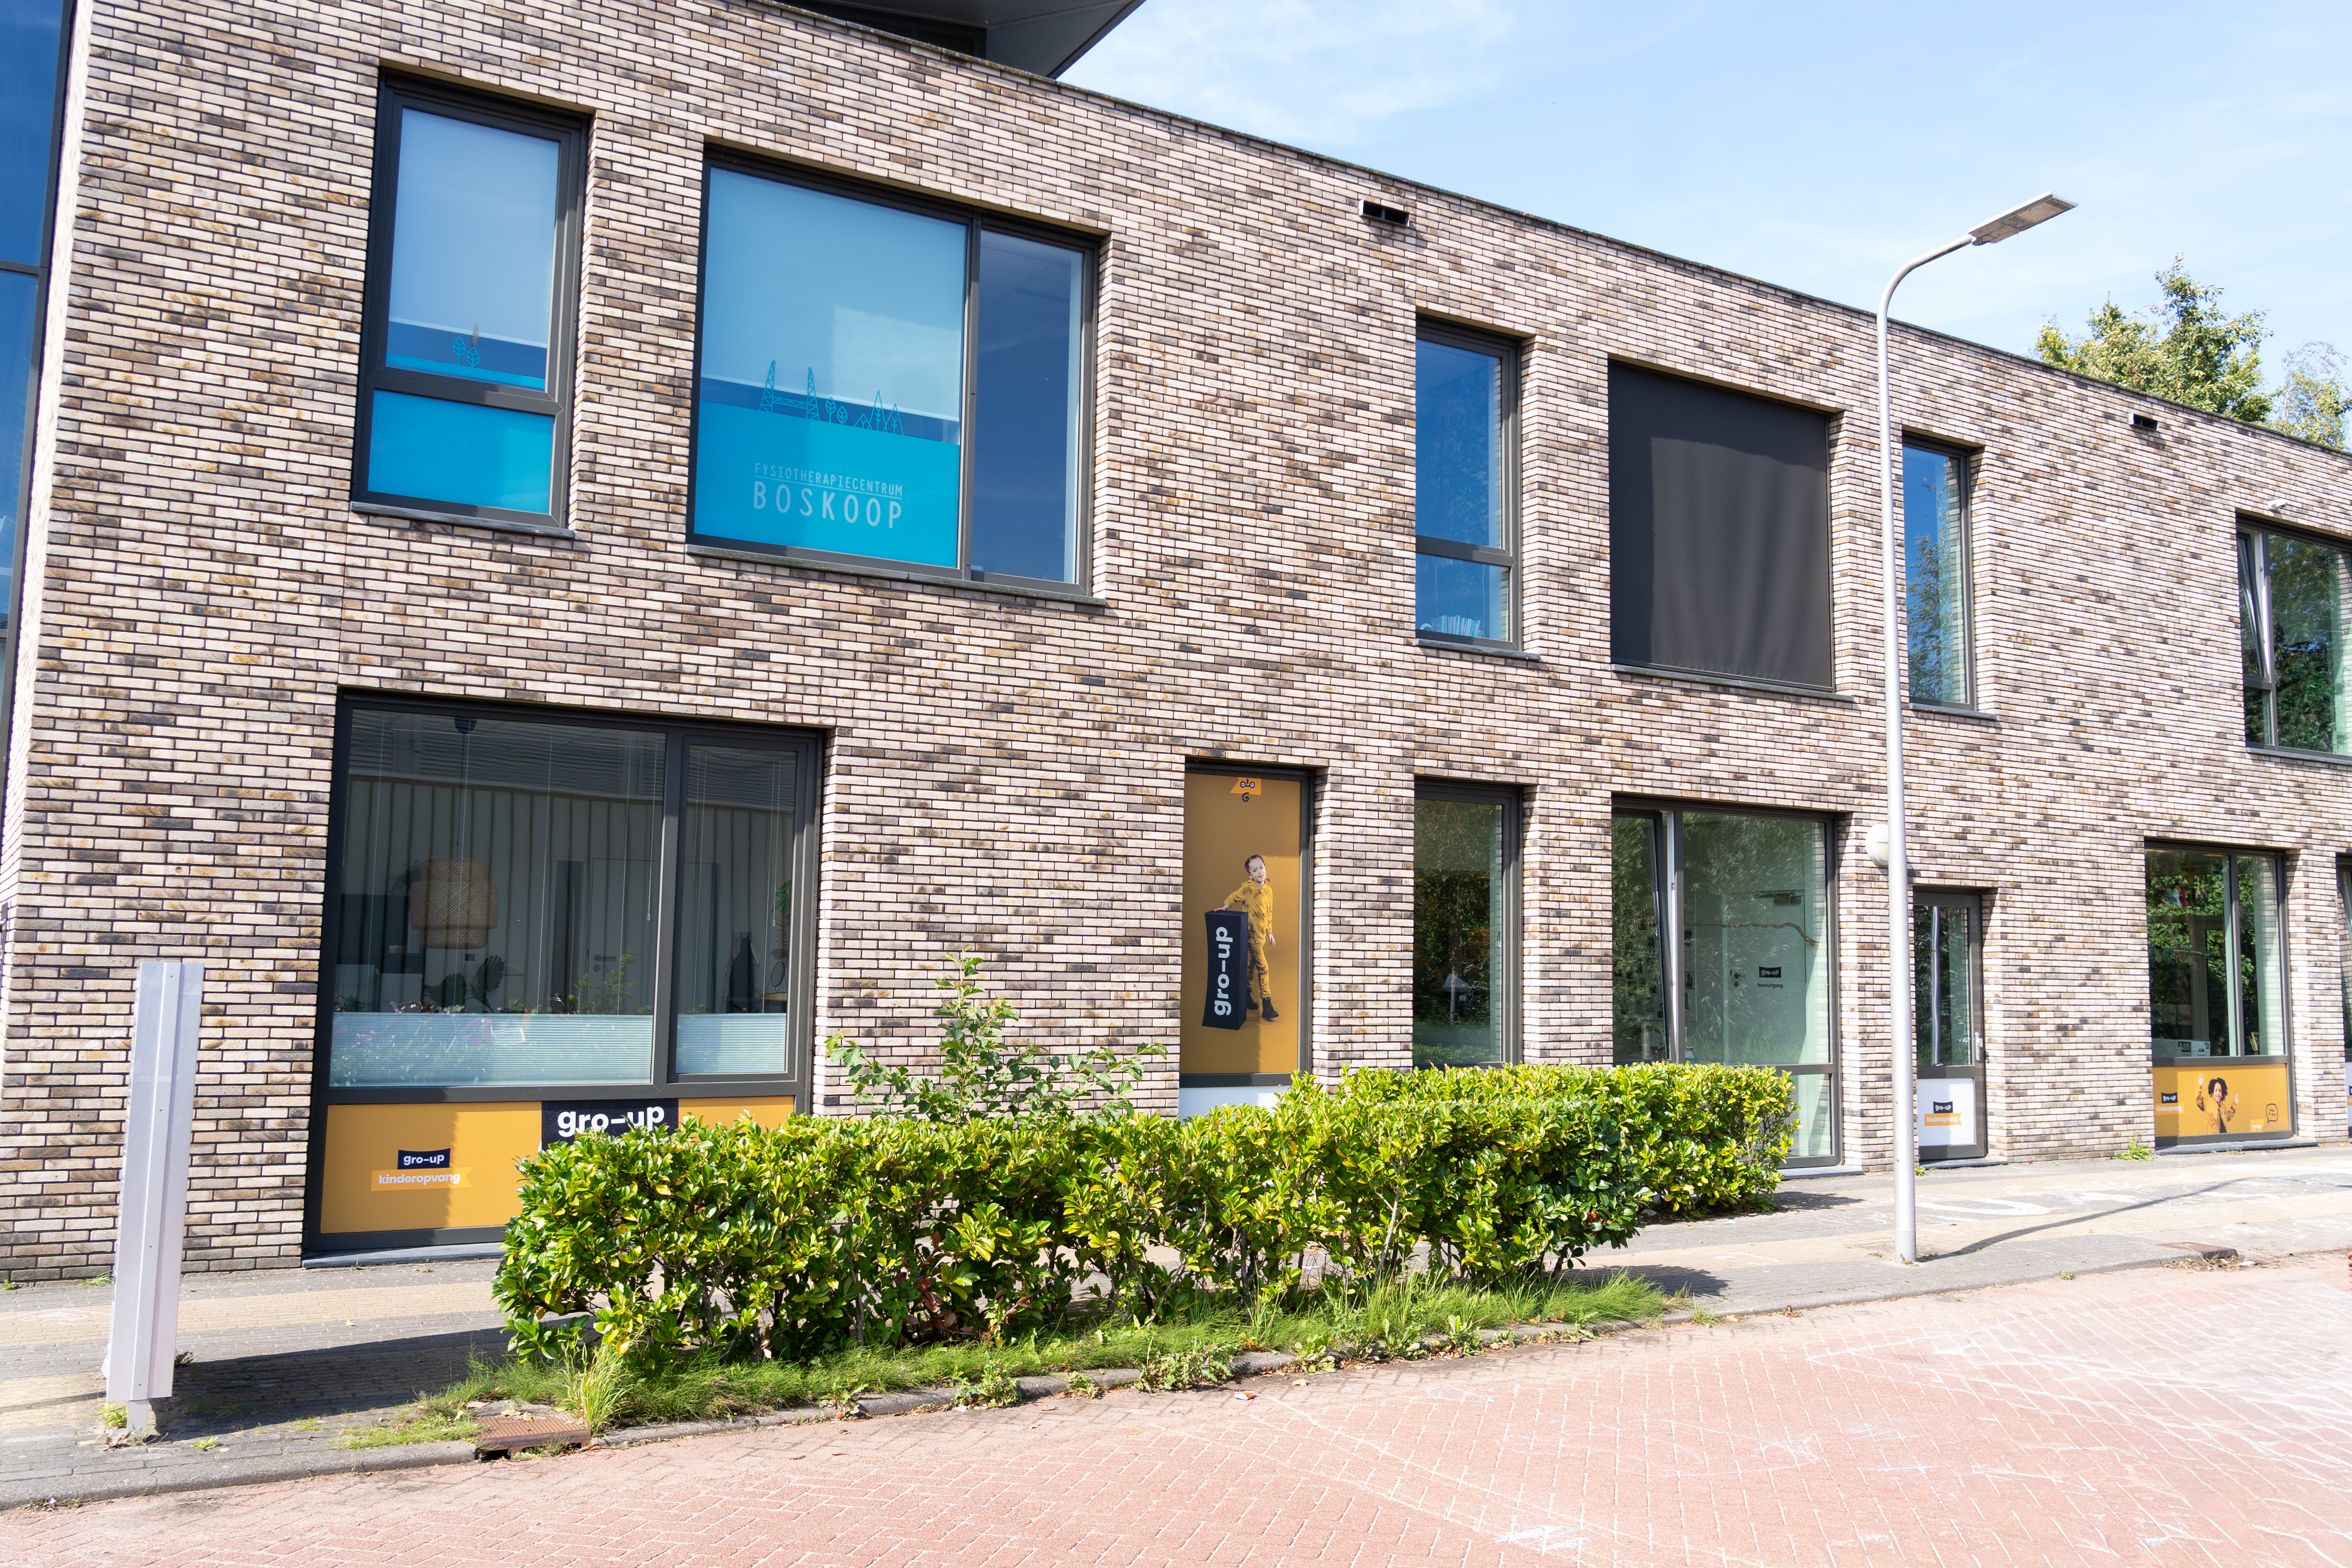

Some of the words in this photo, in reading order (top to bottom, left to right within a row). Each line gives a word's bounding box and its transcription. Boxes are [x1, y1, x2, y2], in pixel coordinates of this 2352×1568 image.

[754, 462, 902, 497] FYSIOTHERAPIECENTRUM
[753, 481, 902, 529] BOSKOOP
[1214, 927, 1233, 1016] gro-up
[557, 1106, 665, 1138] gro-up
[403, 1154, 445, 1166] gro-up
[378, 1174, 461, 1185] kinderopvang
